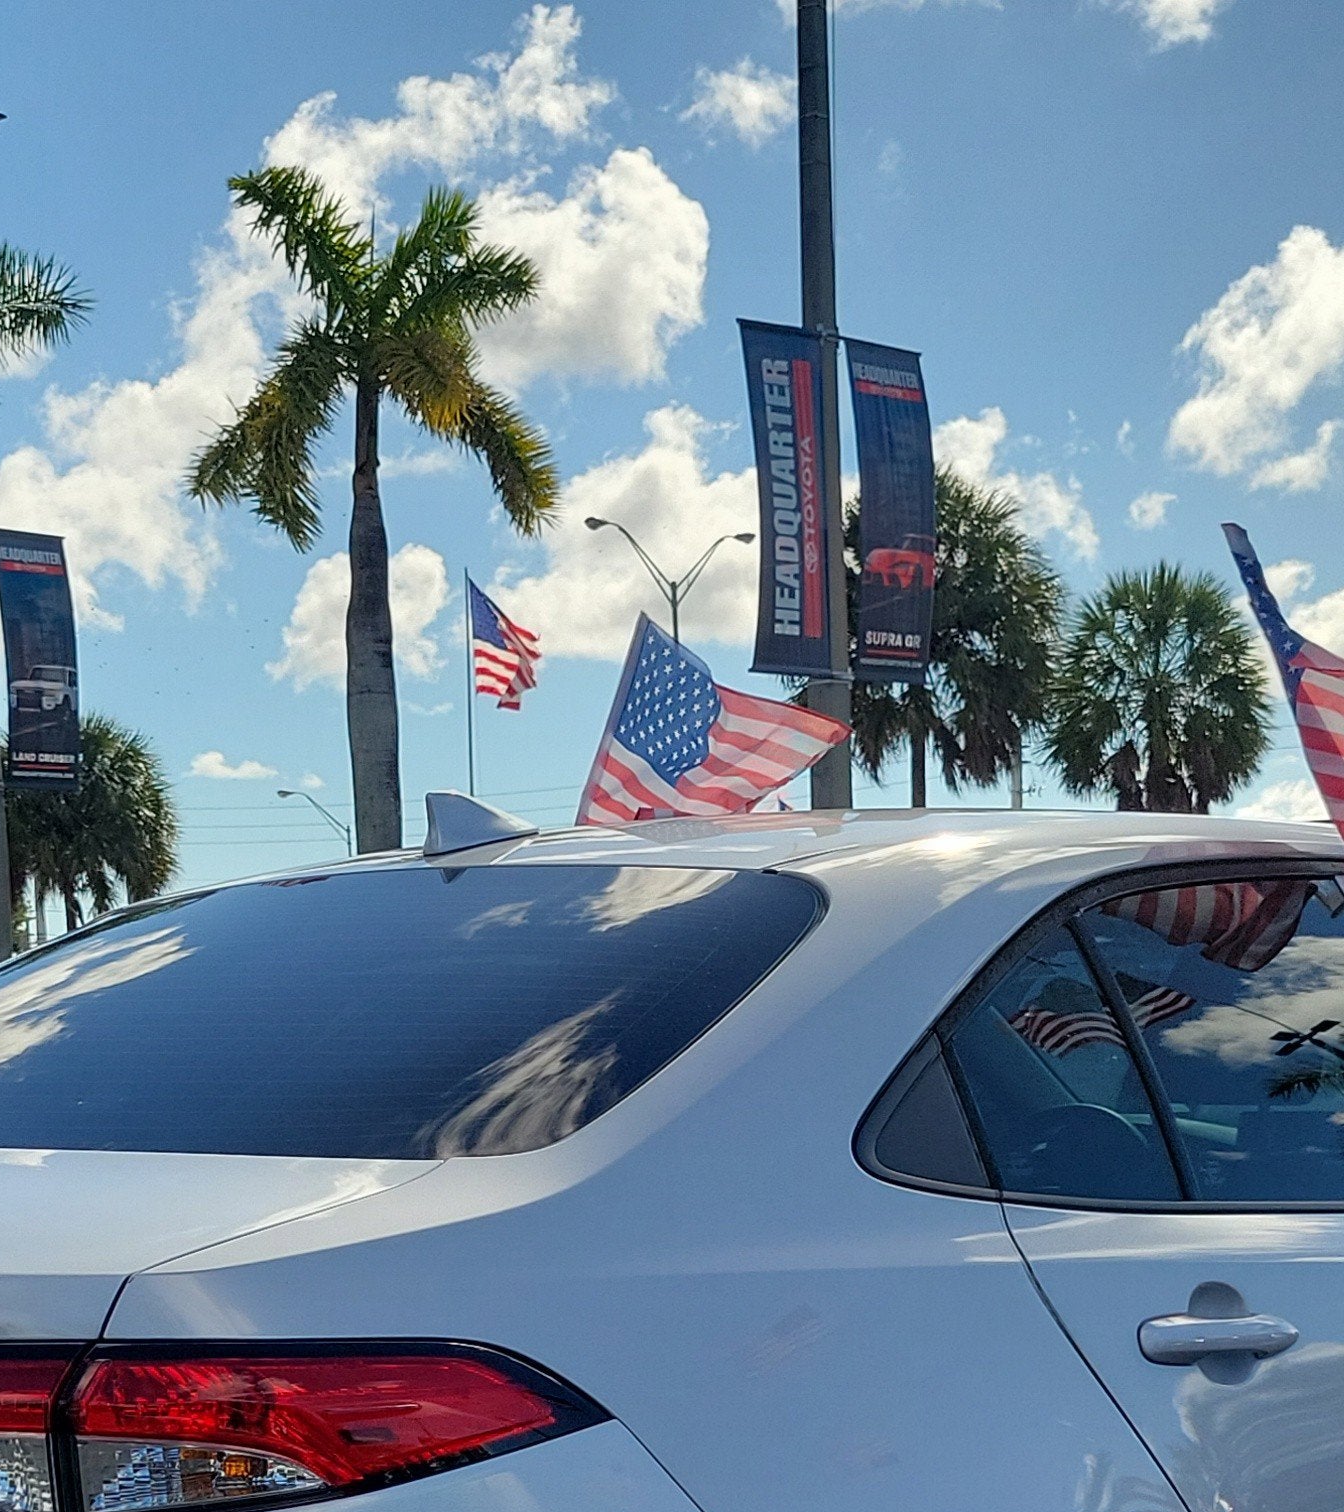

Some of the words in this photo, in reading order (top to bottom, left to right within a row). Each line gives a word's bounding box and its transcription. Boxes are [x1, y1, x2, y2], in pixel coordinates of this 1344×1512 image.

[761, 358, 801, 637] HEADQUARTER
[800, 436, 816, 538] TOYOTA
[865, 630, 903, 647] SUPRA
[12, 751, 37, 762] LAND
[38, 752, 75, 764] CRUISER
